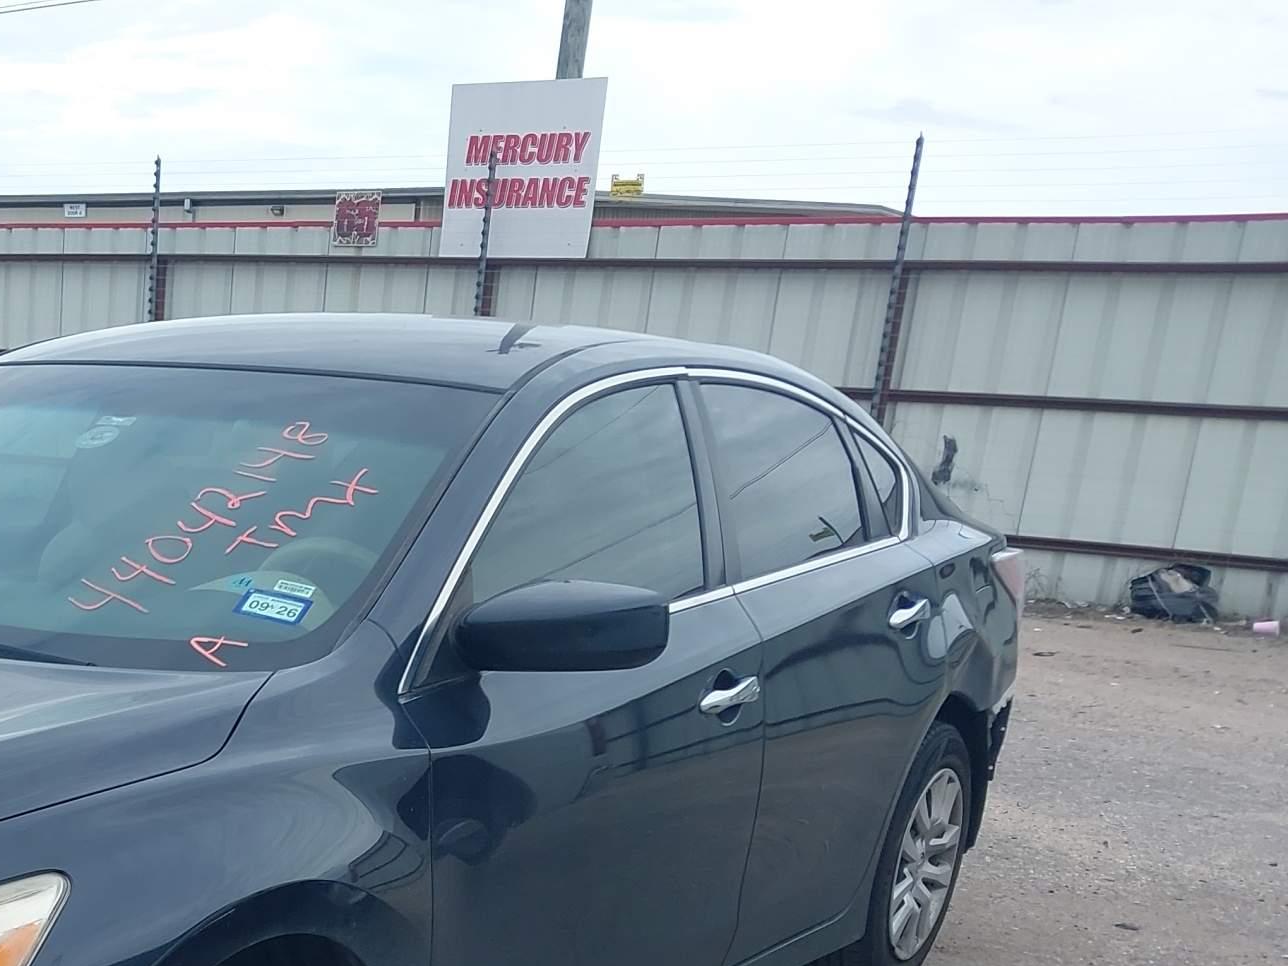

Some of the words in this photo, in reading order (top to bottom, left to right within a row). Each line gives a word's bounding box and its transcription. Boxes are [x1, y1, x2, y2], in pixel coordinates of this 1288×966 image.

[465, 131, 592, 167] MERCURY
[447, 176, 591, 210] INSURANCE
[67, 421, 329, 614] 44042148
[248, 600, 270, 612] 09
[275, 605, 299, 618] 26
[189, 635, 249, 667] A
